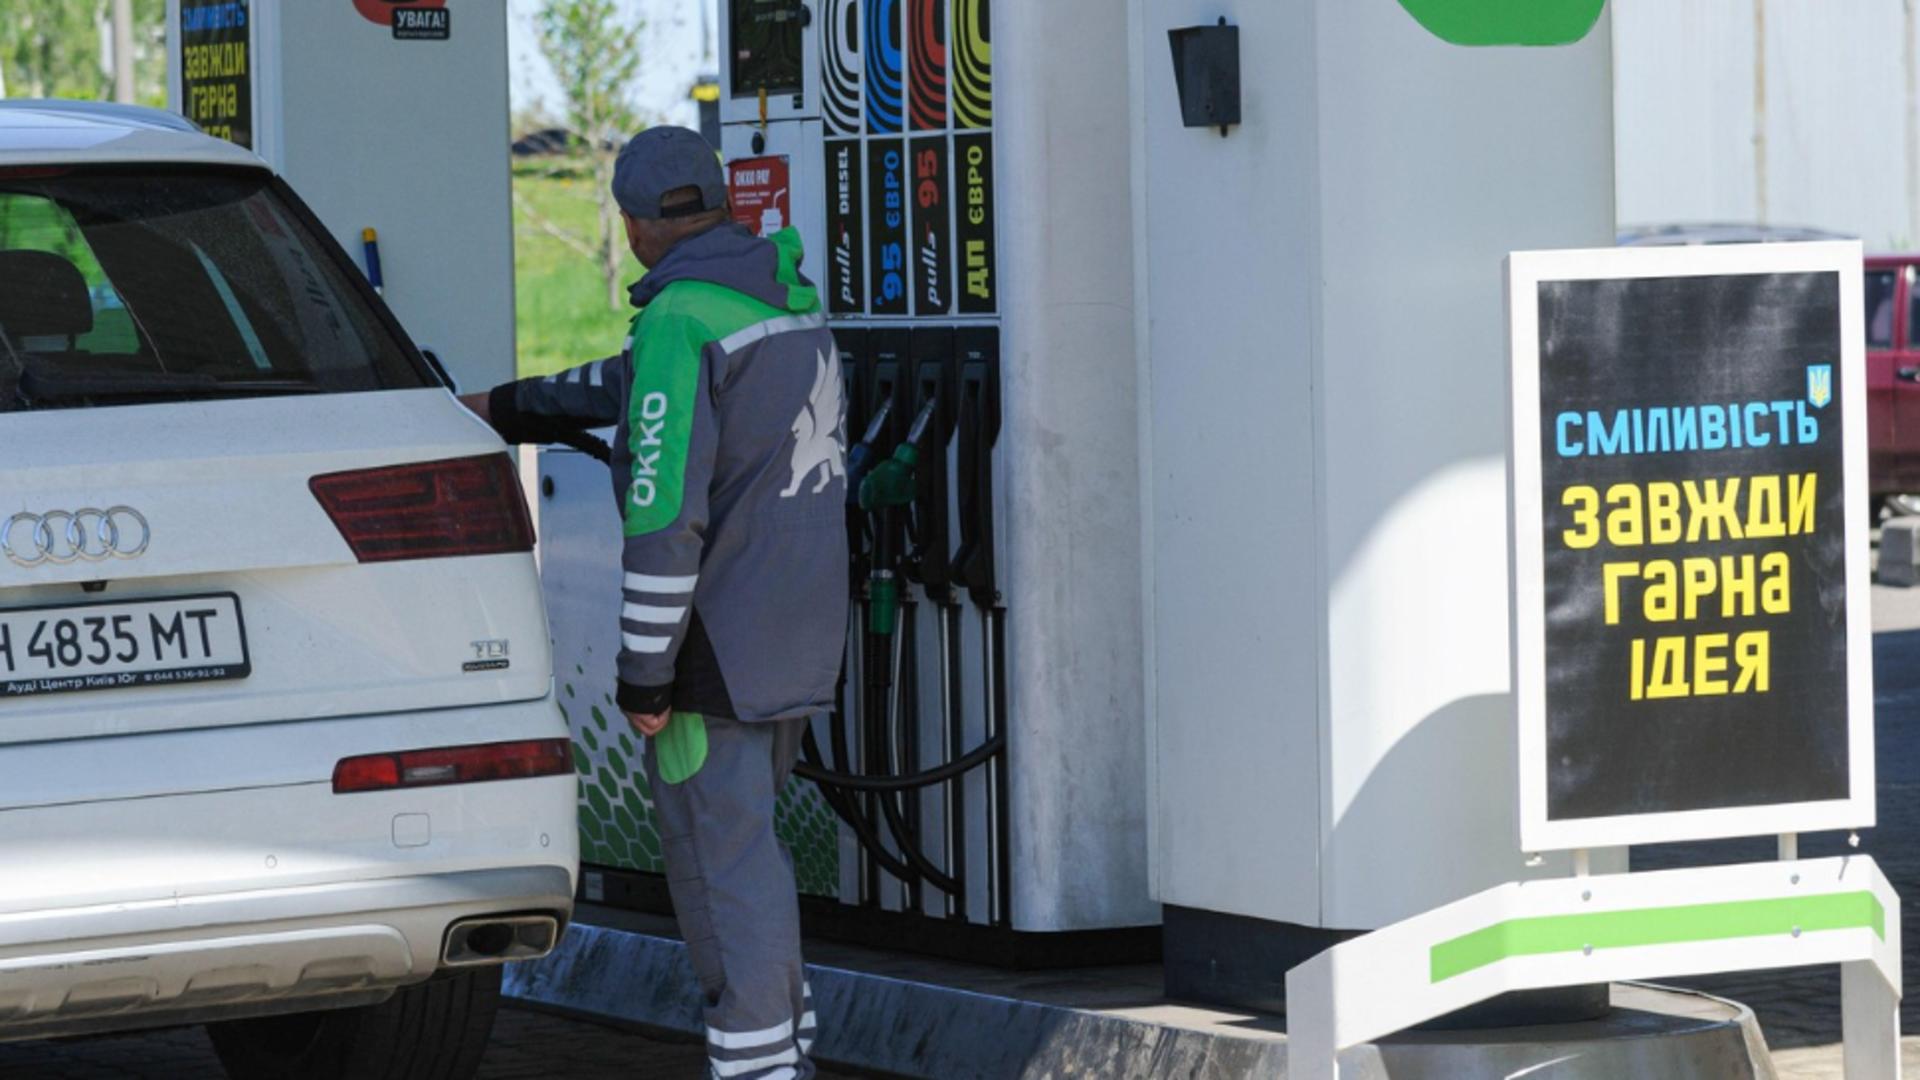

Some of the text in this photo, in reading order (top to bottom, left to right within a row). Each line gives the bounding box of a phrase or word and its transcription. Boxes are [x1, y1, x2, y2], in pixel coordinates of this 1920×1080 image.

[397, 10, 445, 28] УВАГА!
[836, 146, 855, 305] pulls DIESEL
[884, 151, 900, 228] ЄВРО
[966, 145, 989, 299] ДП ЄВРО
[917, 149, 941, 306] pulls 95
[633, 391, 667, 507] OKKO
[1556, 400, 1819, 457] СМІЛИВІСТЬ
[27, 615, 139, 668] 4835
[149, 609, 217, 661] MT
[1630, 631, 1770, 700] ІДЕЯ
[7, 680, 36, 693] Ауді
[40, 679, 83, 690] Центр
[86, 675, 115, 686] Київ
[118, 673, 137, 684] Юг
